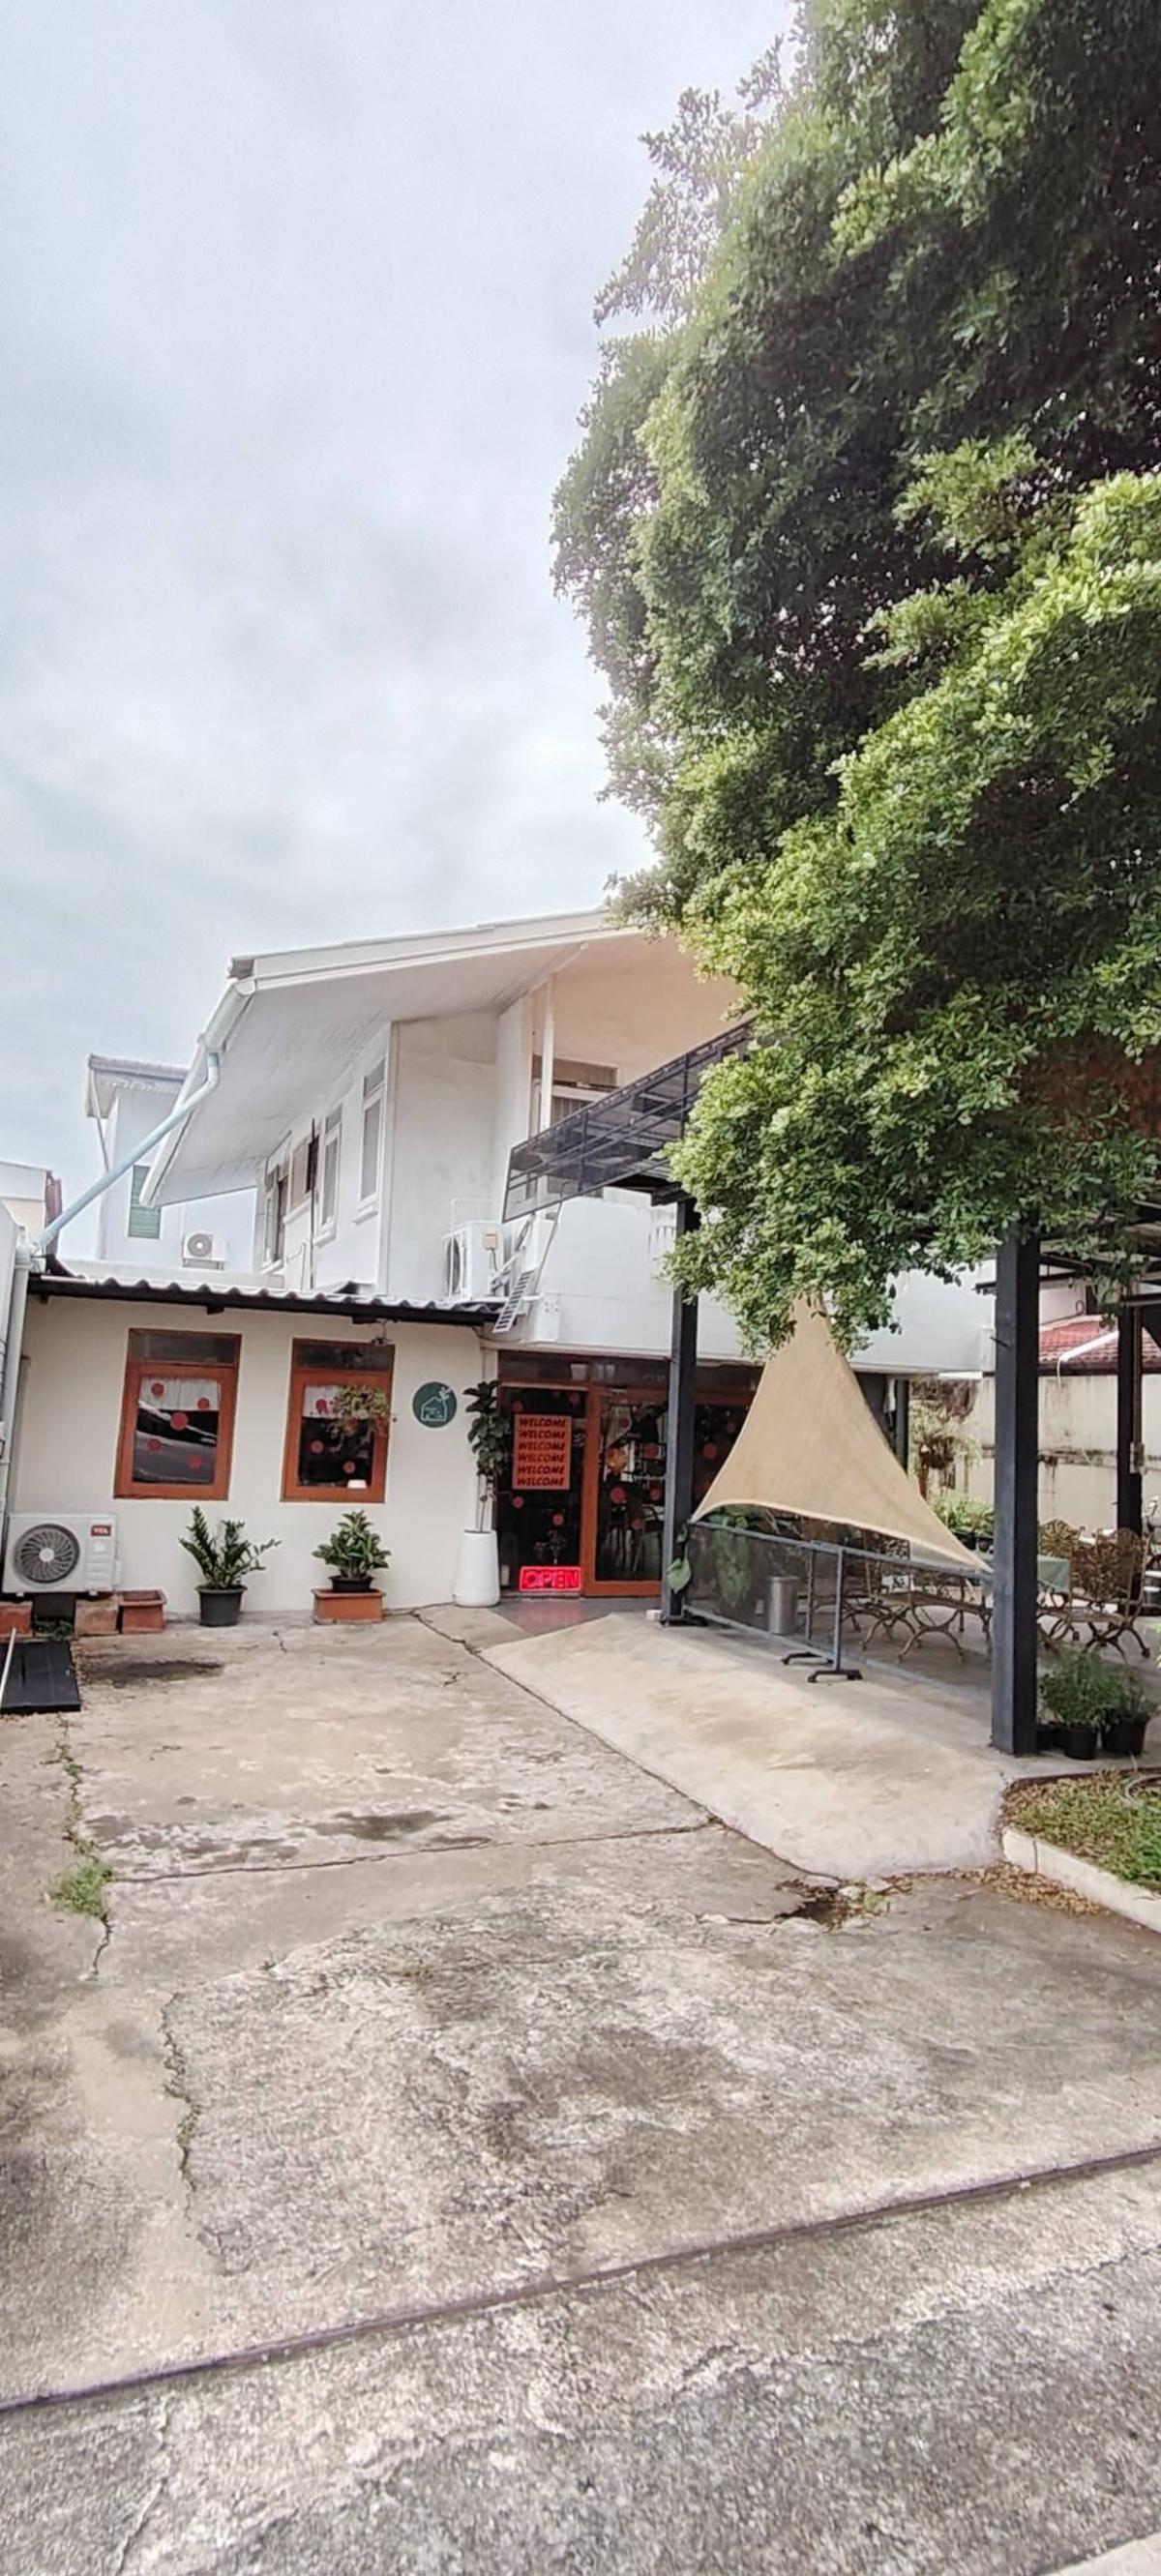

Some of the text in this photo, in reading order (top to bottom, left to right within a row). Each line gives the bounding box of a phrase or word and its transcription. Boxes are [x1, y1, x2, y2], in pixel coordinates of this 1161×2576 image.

[520, 1418, 566, 1427] WELCOME
[519, 1431, 566, 1439] WELCOME
[518, 1441, 565, 1450] WELCOME
[518, 1453, 565, 1462] WELCOME
[518, 1466, 565, 1474] WELCOME
[517, 1477, 564, 1486] WELCOME
[523, 1570, 579, 1587] OPEN
